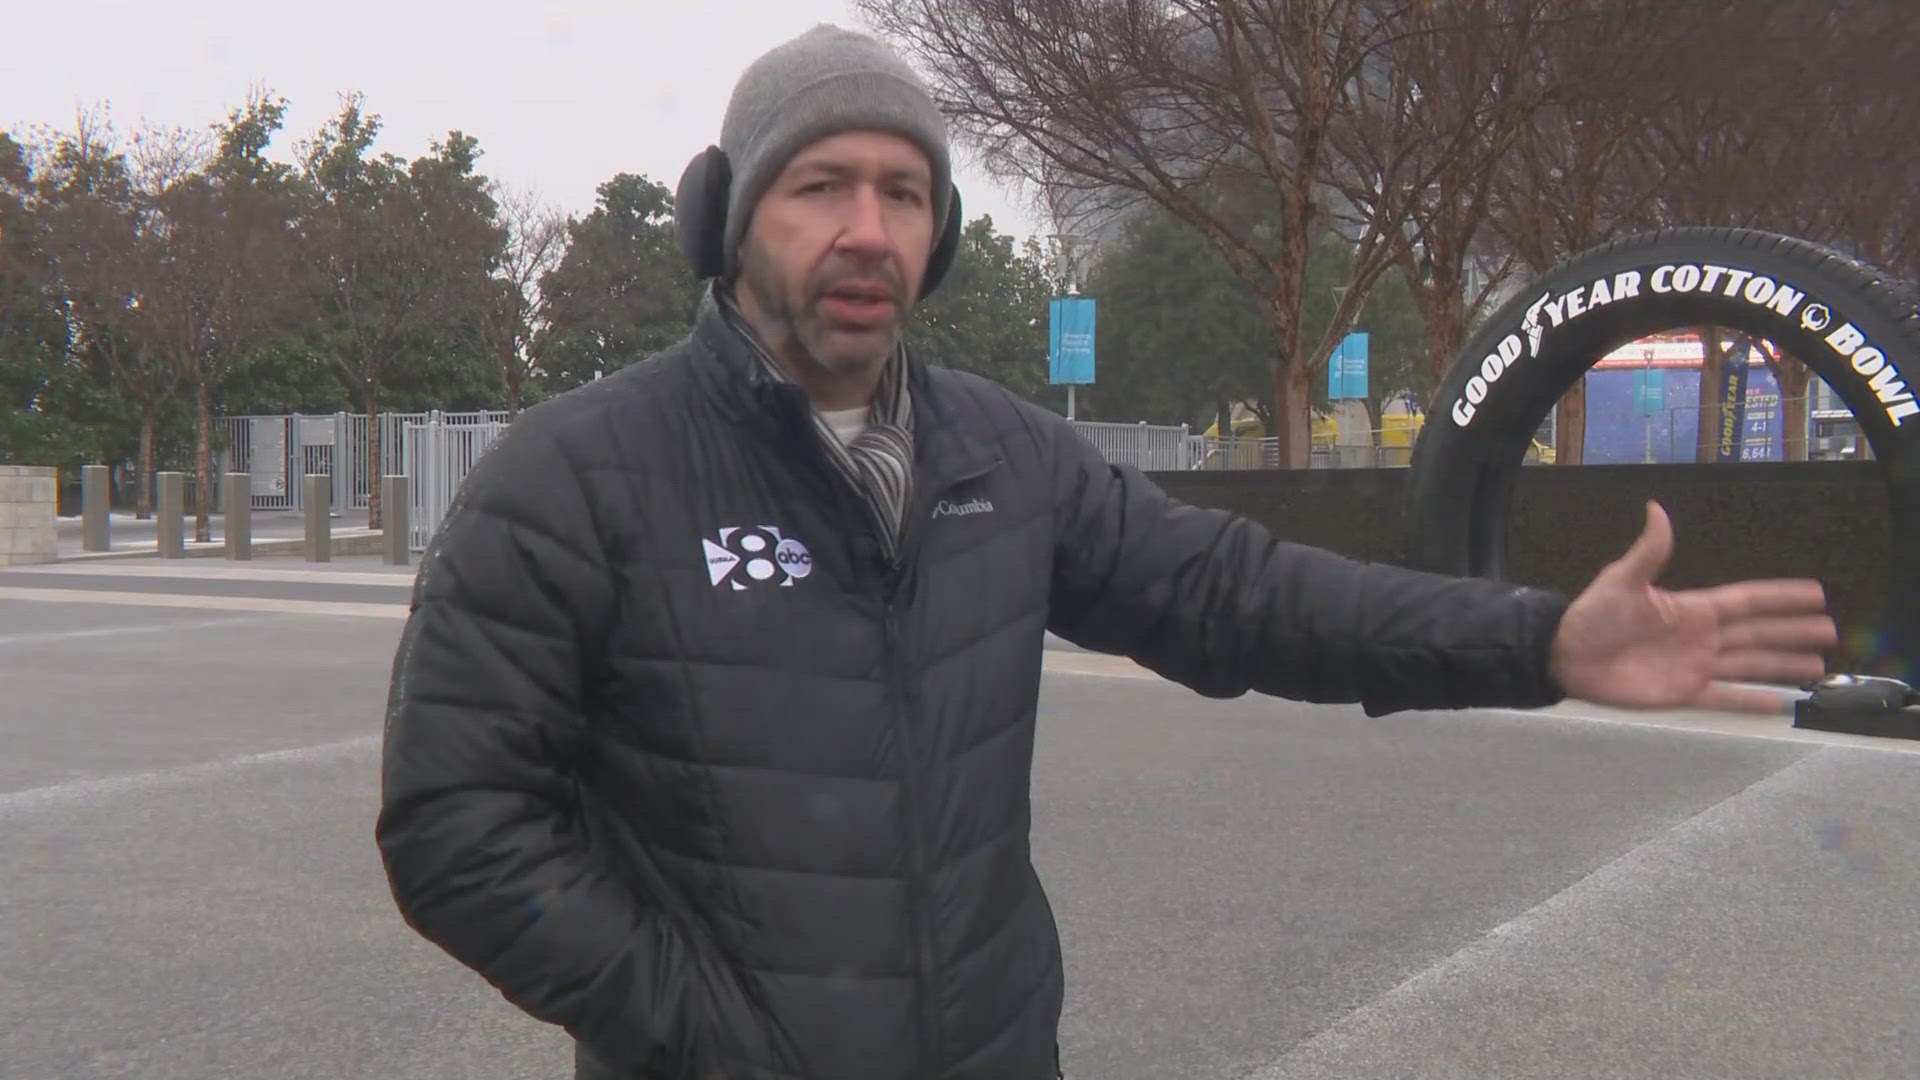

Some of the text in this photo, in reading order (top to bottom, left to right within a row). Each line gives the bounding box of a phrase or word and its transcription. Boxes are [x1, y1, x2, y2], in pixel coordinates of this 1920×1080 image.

[1650, 264, 1805, 317] COTTON
[1825, 322, 1920, 427] BOWL
[938, 498, 994, 516] Columbia
[778, 547, 811, 565] abc
